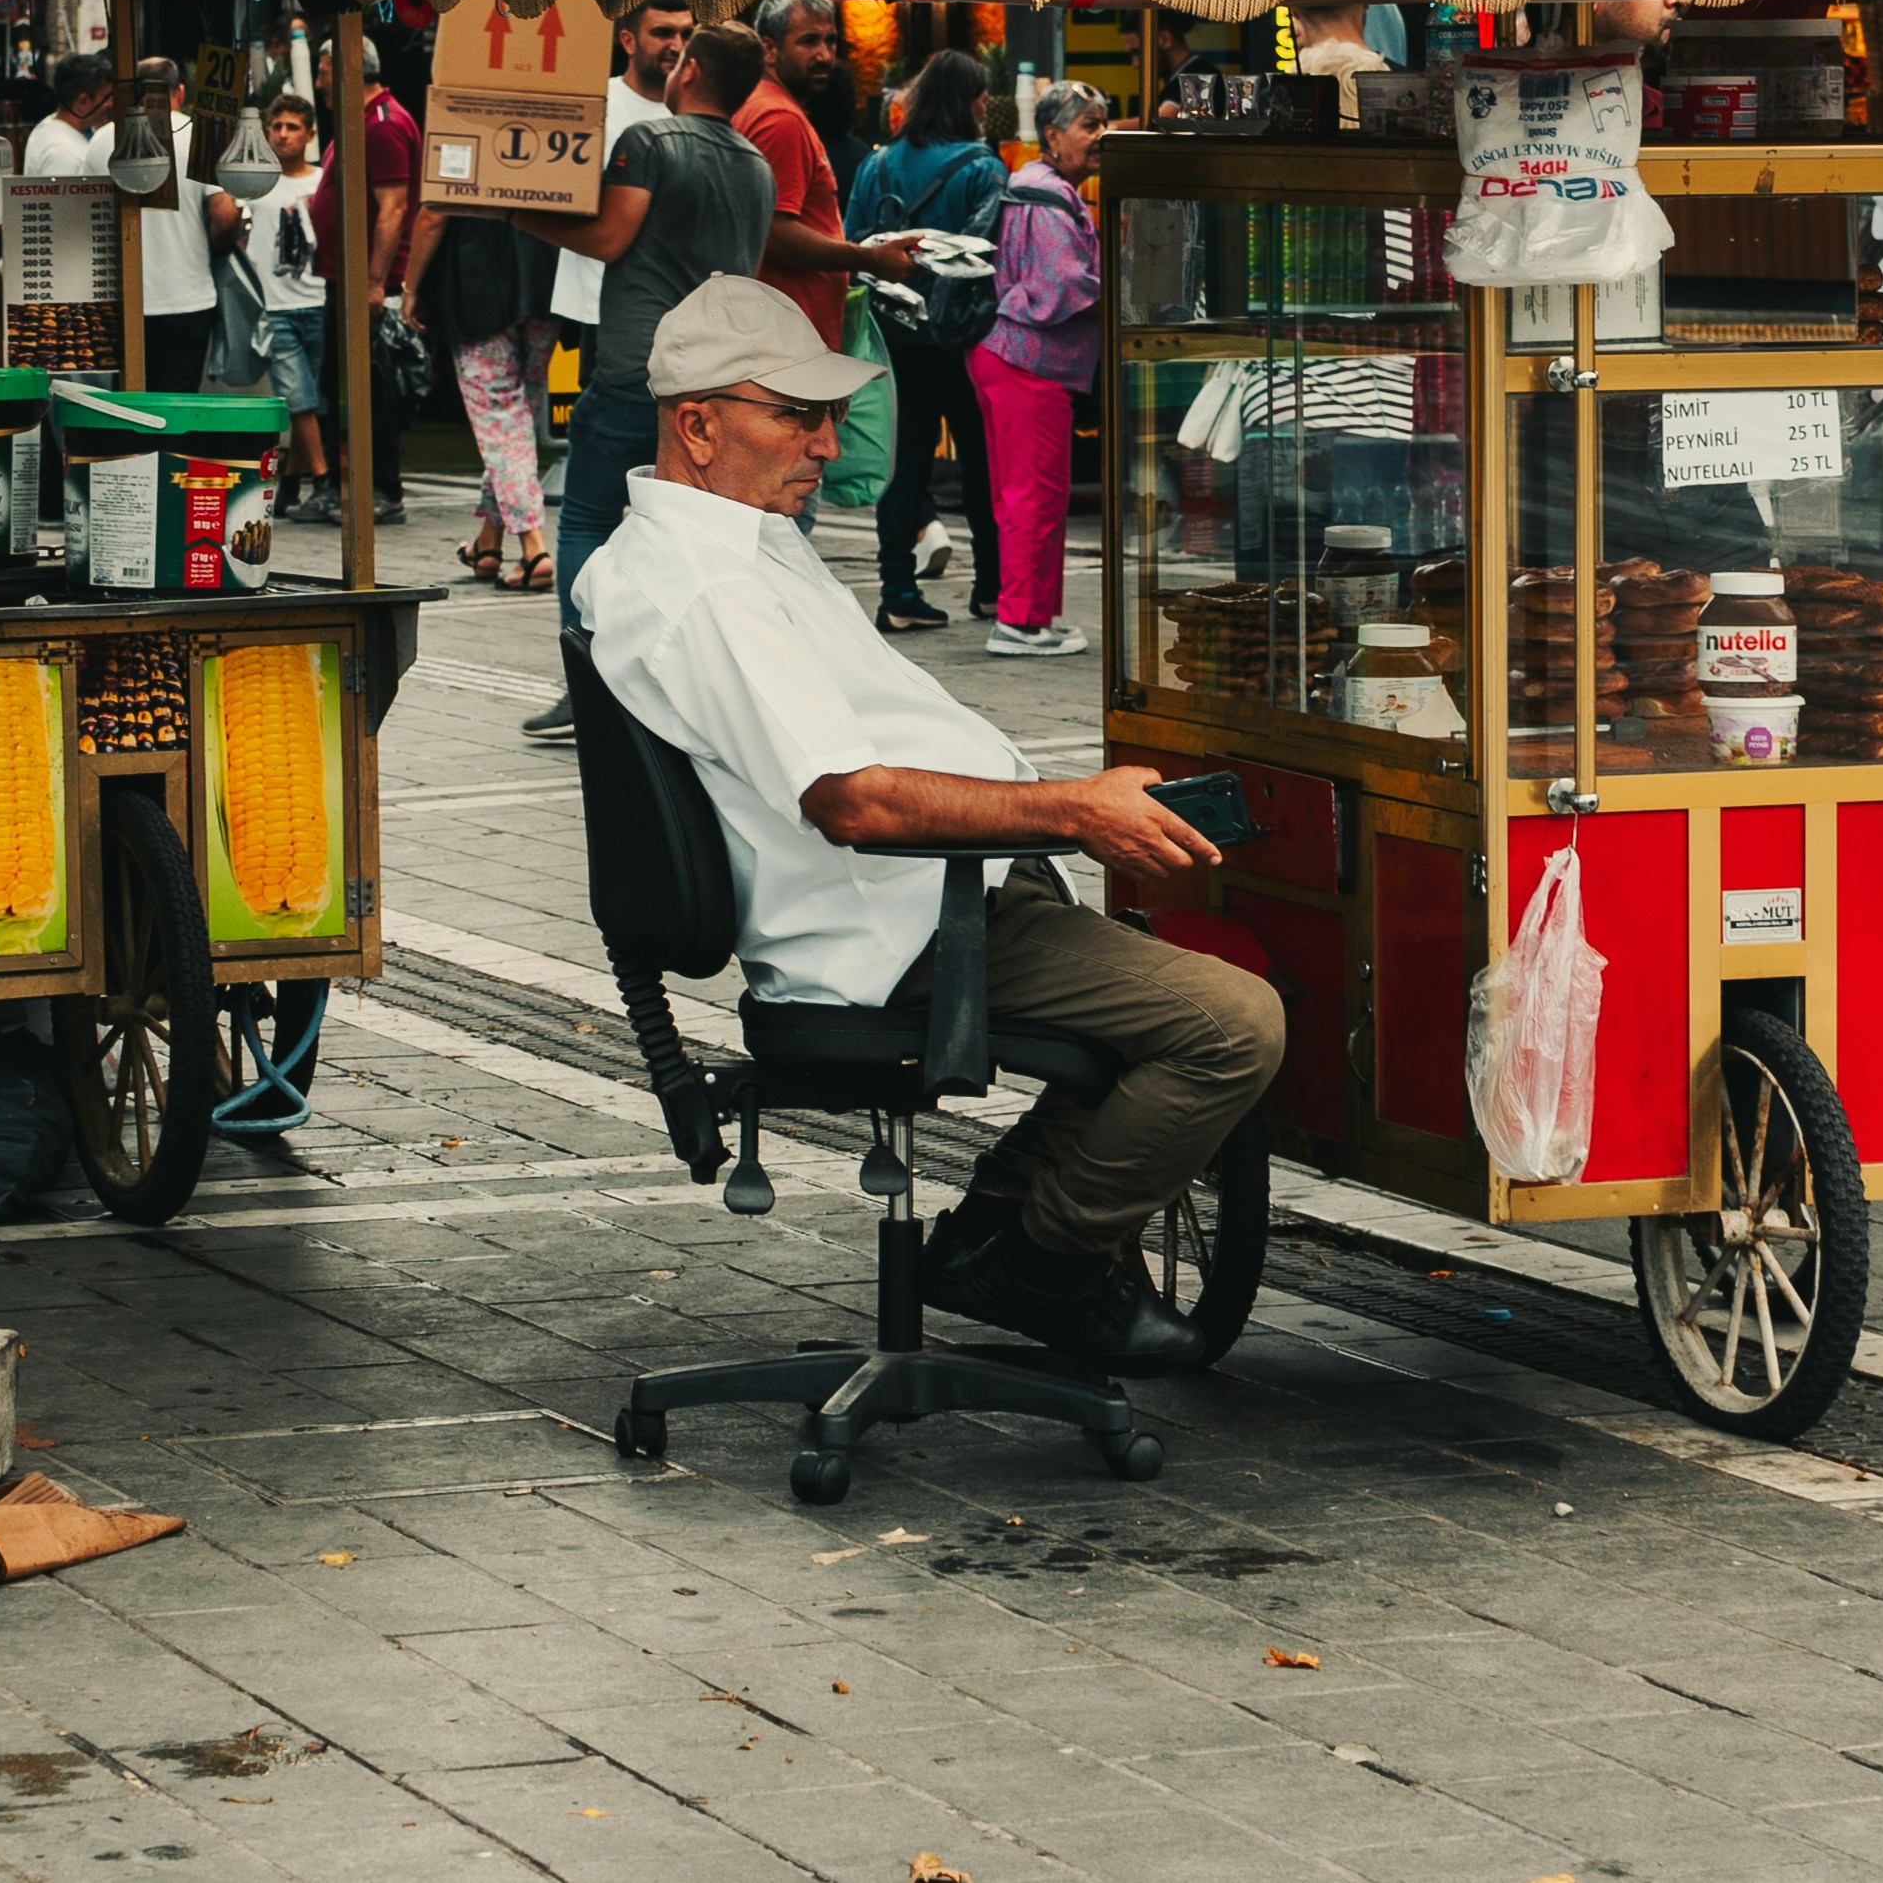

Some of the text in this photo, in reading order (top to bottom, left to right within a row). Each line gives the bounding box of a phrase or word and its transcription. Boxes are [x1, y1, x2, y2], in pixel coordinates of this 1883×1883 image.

[204, 50, 236, 92] 20
[1519, 100, 1571, 111] 250 Adet
[1528, 127, 1558, 138] Small
[501, 128, 593, 166] 26 T
[1470, 143, 1622, 172] HIŞIR MARKET POŞET
[1519, 160, 1568, 176] HDPE
[10, 184, 61, 197] KESTANE
[68, 183, 113, 195] CHESTN
[444, 183, 480, 198] KOLİ
[1664, 391, 1829, 419] SİMİT 10 TL
[1666, 423, 1830, 451] PEYNİRLİ 25 TL
[1667, 454, 1833, 482] NUTELLALI 25 TL
[1706, 629, 1787, 651] nutella
